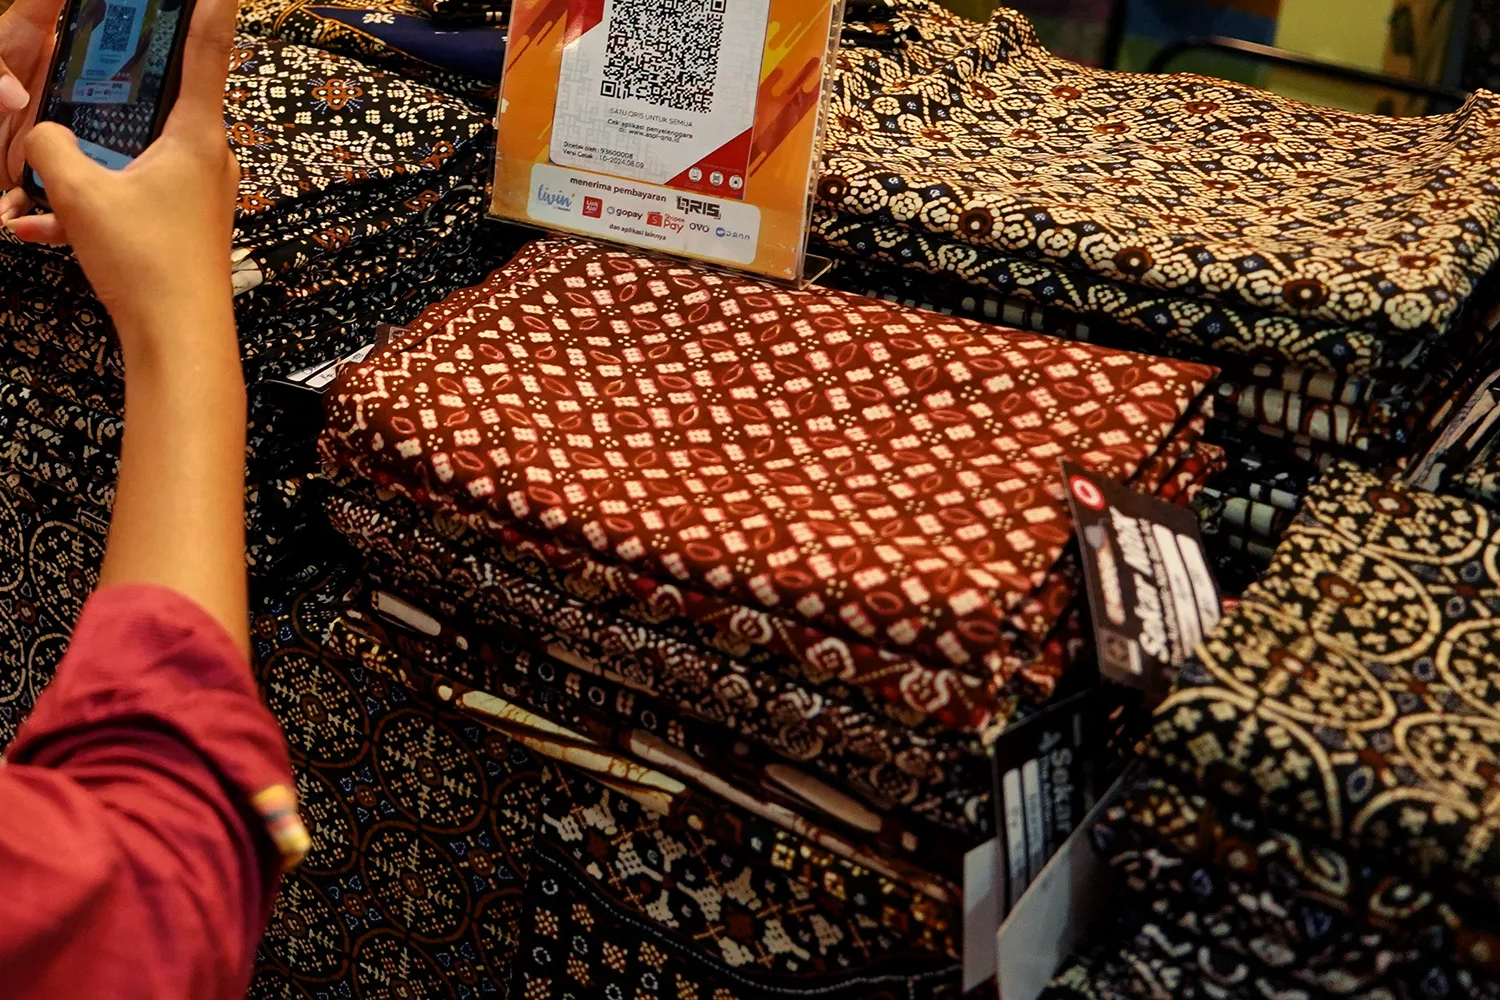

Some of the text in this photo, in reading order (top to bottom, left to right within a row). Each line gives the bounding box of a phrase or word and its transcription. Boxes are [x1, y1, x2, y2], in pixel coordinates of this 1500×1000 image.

[610, 107, 627, 116] SATU
[645, 114, 668, 123] UNTUK
[669, 118, 693, 127] SEMUA
[570, 177, 667, 203] menerima pembayaran
[616, 208, 644, 221] gopay
[676, 195, 721, 220] QRIS
[609, 223, 667, 240] dan aplikasi lainnya
[689, 222, 710, 233] OVO
